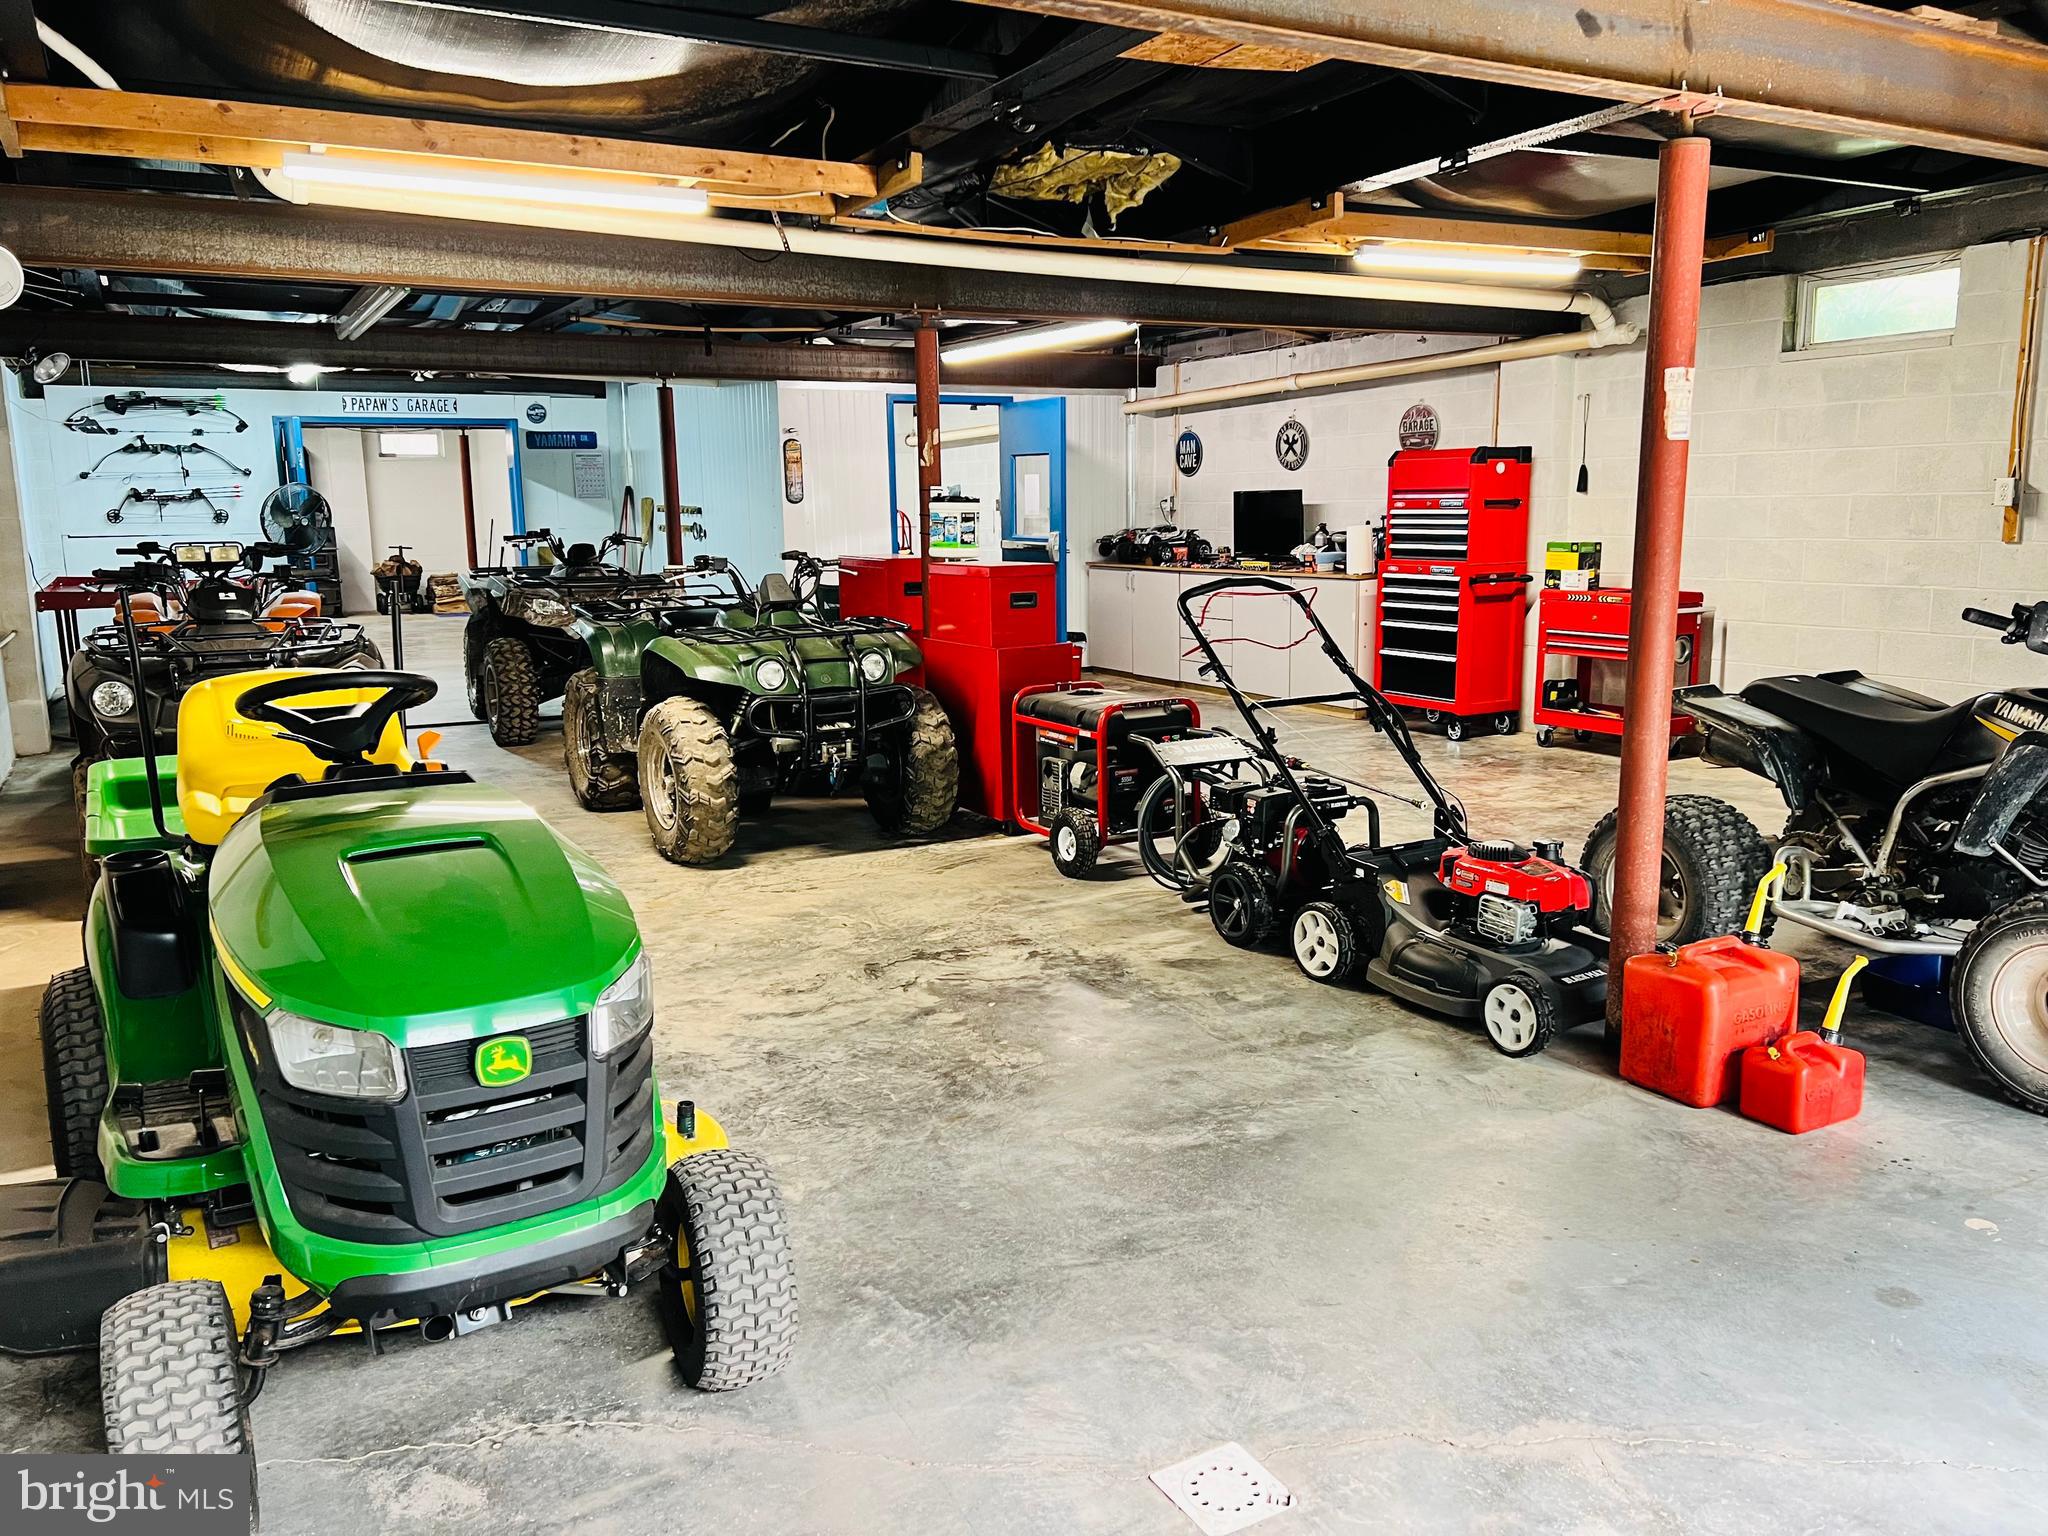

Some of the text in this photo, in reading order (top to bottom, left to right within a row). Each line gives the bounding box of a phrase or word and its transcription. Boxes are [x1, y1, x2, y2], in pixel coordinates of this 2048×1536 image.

[351, 397, 449, 412] PAPAW'S GARAGE
[1402, 418, 1434, 432] GARAGE
[534, 433, 577, 447] YAMAHA
[1179, 439, 1196, 454] MAN
[1179, 453, 1197, 469] CAVE
